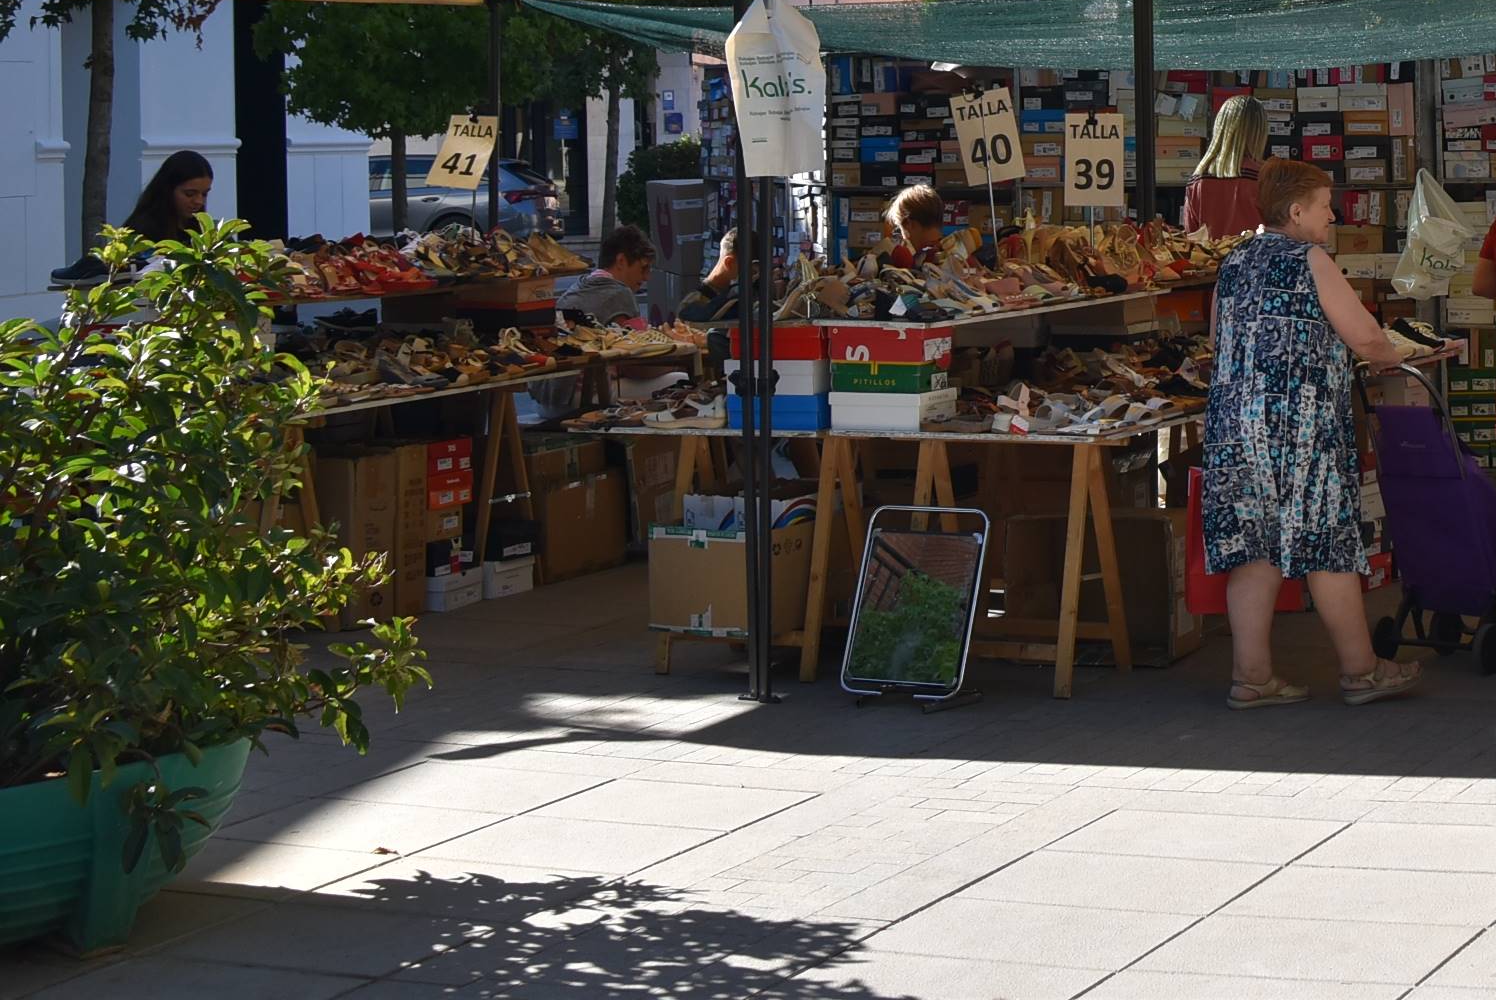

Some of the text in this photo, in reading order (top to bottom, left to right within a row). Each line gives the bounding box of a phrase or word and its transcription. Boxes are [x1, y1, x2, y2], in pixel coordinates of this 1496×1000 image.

[955, 97, 1010, 122] TALLA
[452, 122, 493, 139] TALLA
[1069, 123, 1120, 140] TALLA
[970, 133, 1013, 169] 40
[441, 152, 477, 176] 41
[1073, 158, 1115, 191] 39
[852, 377, 897, 386] PITILLOS
